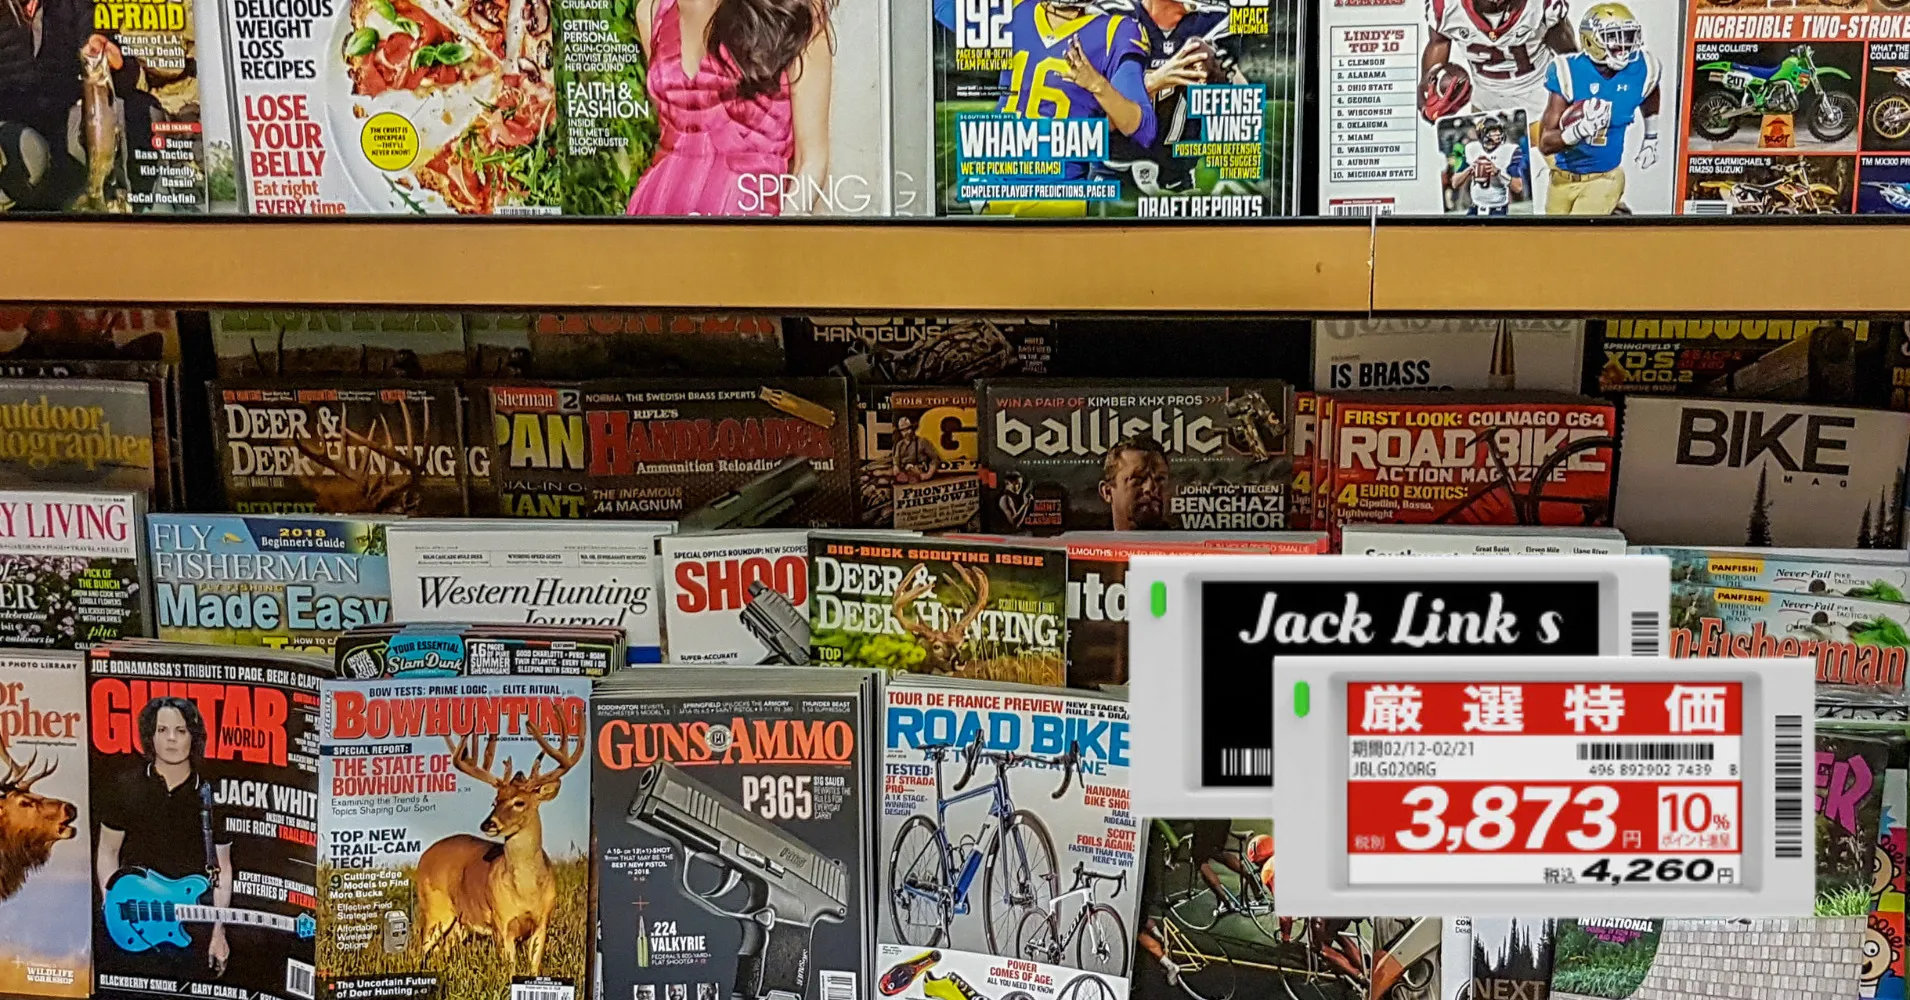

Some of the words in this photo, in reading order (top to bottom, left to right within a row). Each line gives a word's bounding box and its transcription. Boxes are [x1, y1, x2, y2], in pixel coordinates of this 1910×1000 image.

[94, 4, 184, 32] AFRAID
[236, 0, 333, 18] DELICIOUS
[1230, 8, 1268, 26] IMPACT
[237, 20, 312, 39] WEIGHT
[563, 20, 609, 32] GETTING
[1695, 16, 1793, 39] INCREDIBLE
[564, 32, 619, 43] PERSONAL
[1344, 30, 1405, 43] LINDY'S
[239, 41, 284, 59] LOSS
[1350, 42, 1377, 53] TOP
[1377, 42, 1399, 52] 10
[1719, 45, 1759, 53] COLLIER'S
[1348, 58, 1386, 66] CLEMSON
[1467, 43, 1536, 79] 21
[1697, 53, 1719, 61] KX500
[241, 60, 316, 80] RECIPES
[567, 82, 614, 99] FAITH
[245, 95, 308, 122] LOSE
[568, 100, 649, 118] FASHION
[1192, 88, 1263, 115] DEFENSE
[248, 124, 322, 149] YOUR
[1205, 116, 1262, 142] WINS?
[961, 122, 1102, 158] WHAM-BAM
[250, 151, 326, 178] BELLY
[1690, 158, 1712, 167] RICKY
[1715, 158, 1771, 167] CARMICHAEL'S
[1347, 170, 1387, 178] MICHIGAN
[254, 181, 280, 196] Eat
[284, 182, 319, 200] right
[738, 173, 870, 211] SPRING
[961, 185, 1000, 198] COMPLETE
[1002, 185, 1034, 198] PLAYOFF
[1087, 185, 1105, 197] PAGE
[310, 200, 346, 214] time
[814, 326, 944, 342] HANDGUNS
[1331, 363, 1350, 387] IS
[1359, 362, 1430, 385] BRASS
[626, 393, 644, 402] THE
[646, 392, 686, 402] SWEDISH
[688, 391, 716, 401] BRASS
[719, 390, 756, 400] EXPERTS
[1087, 396, 1136, 407] KIMBER
[1139, 396, 1164, 406] KHX
[1168, 395, 1203, 406] PROS
[224, 405, 310, 438] DEER
[1344, 410, 1400, 426] FIRST
[1406, 410, 1461, 426] LOOK:
[1468, 411, 1559, 427] COLNAGO
[1565, 412, 1605, 428] C64
[1339, 428, 1476, 468] ROAD
[1676, 407, 1855, 474] BIKE
[636, 461, 714, 474] Ammunition
[1376, 468, 1455, 482] ACTION
[619, 487, 682, 498] INFAMOUS
[1361, 485, 1398, 498] EURO
[1403, 485, 1468, 499] EXOTICS:
[617, 500, 682, 512] MAGNUM
[1170, 498, 1284, 514] BENGHAZI
[29, 504, 127, 541] LIVING
[1181, 514, 1284, 529] WARRIOR
[153, 524, 214, 551] FLY
[280, 528, 326, 538] 2018
[261, 536, 313, 549] Beginner's
[316, 538, 345, 548] Guide
[674, 550, 701, 559] SPECIAL
[704, 549, 726, 558] OPTICS
[728, 548, 763, 557] ROUNDUP:
[827, 544, 903, 559] BIG-BUCK
[908, 550, 989, 563] SCOUTING
[996, 554, 1044, 566] ISSUE
[153, 552, 361, 582] FISHERMAN
[816, 557, 904, 597] DEER
[156, 584, 278, 629] Made
[287, 585, 389, 631] Easy
[1239, 591, 1376, 644] Jack
[1391, 591, 1519, 648] Link
[418, 641, 459, 652] ESSENTIAL
[818, 648, 841, 661] TOP
[388, 656, 424, 671] Slam
[426, 651, 462, 671] Dunk
[471, 658, 509, 668] SUMMER
[91, 661, 107, 673] JOE
[110, 662, 182, 676] BONAMASSA'S
[184, 665, 222, 679] TRIBUTE
[224, 666, 236, 679] TO
[267, 669, 288, 684] BECK
[370, 686, 389, 697] BOW
[391, 686, 426, 696] TESTS:
[429, 686, 459, 694] PRIME
[462, 685, 487, 694] LOGIC
[503, 685, 526, 694] ELITE
[528, 685, 559, 694] RITUAL
[888, 691, 922, 706] TOUR
[926, 694, 943, 706] DE
[948, 695, 1000, 710] FRANCE
[1004, 698, 1063, 713] PREVIEW
[333, 691, 586, 739] BOWHUNTING
[222, 726, 266, 749] WORLD
[599, 719, 711, 770] GUNS
[888, 707, 1021, 752] ROAD
[1031, 714, 1130, 767] BIKE
[334, 746, 370, 755] SPECIAL
[372, 744, 408, 754] REPORT:
[332, 757, 366, 776] THE
[373, 756, 424, 775] STATE
[431, 755, 452, 773] OF
[886, 764, 933, 776] TESTED:
[332, 775, 456, 796] BOWHUNTING
[899, 776, 935, 786] STRADA
[214, 780, 271, 809] JACK
[742, 776, 813, 820] P365
[226, 818, 249, 834] INDIE
[252, 822, 277, 837] ROCK
[1396, 786, 1620, 852] 3,873
[1624, 831, 1641, 848] 円
[331, 830, 365, 843] TOP
[370, 829, 406, 842] NEW
[1107, 828, 1136, 840] SCOTT
[331, 841, 421, 855] TRAIL-CAM
[331, 856, 373, 869] TECH
[344, 871, 402, 882] Cutting-Edge
[1544, 869, 1575, 884] 税込
[1581, 859, 1714, 885] 4,260
[1717, 869, 1733, 884] 円
[651, 921, 676, 936] .224
[651, 936, 705, 952] VALKYRIE
[101, 974, 148, 989] BLACKBERRY
[150, 979, 177, 992] SMOKE
[1472, 979, 1545, 999] NEXT
